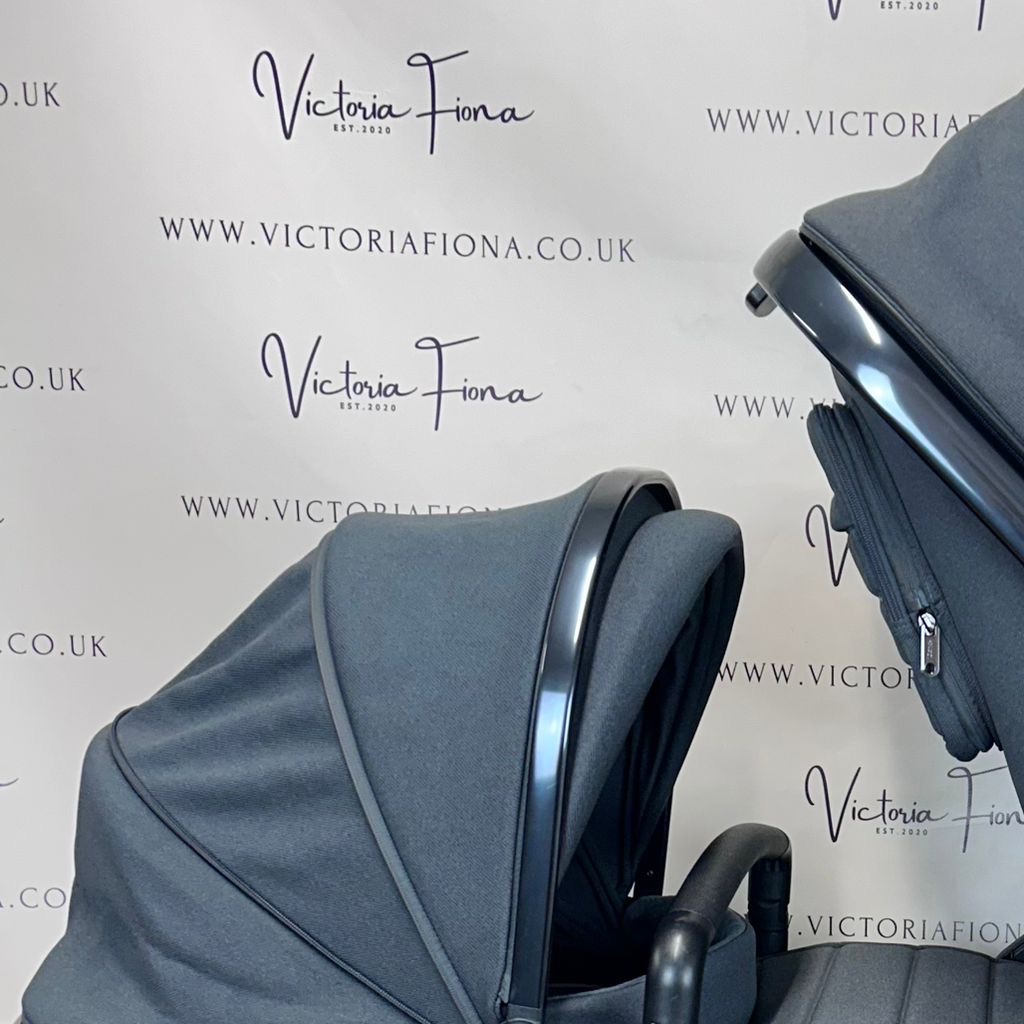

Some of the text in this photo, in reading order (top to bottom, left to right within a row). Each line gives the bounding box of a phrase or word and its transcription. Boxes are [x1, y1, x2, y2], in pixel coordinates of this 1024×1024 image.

[880, 1, 939, 11] EST.2020
[251, 50, 536, 155] Victoria Fiona
[333, 123, 391, 135] EST.2020
[158, 216, 636, 263] WWW.VICTORIAFIONA.CO.UK
[261, 332, 544, 431] Victoria Fiona
[339, 402, 397, 412] EST.2020
[805, 765, 948, 843] Victoria
[875, 827, 929, 836] EST.2020
